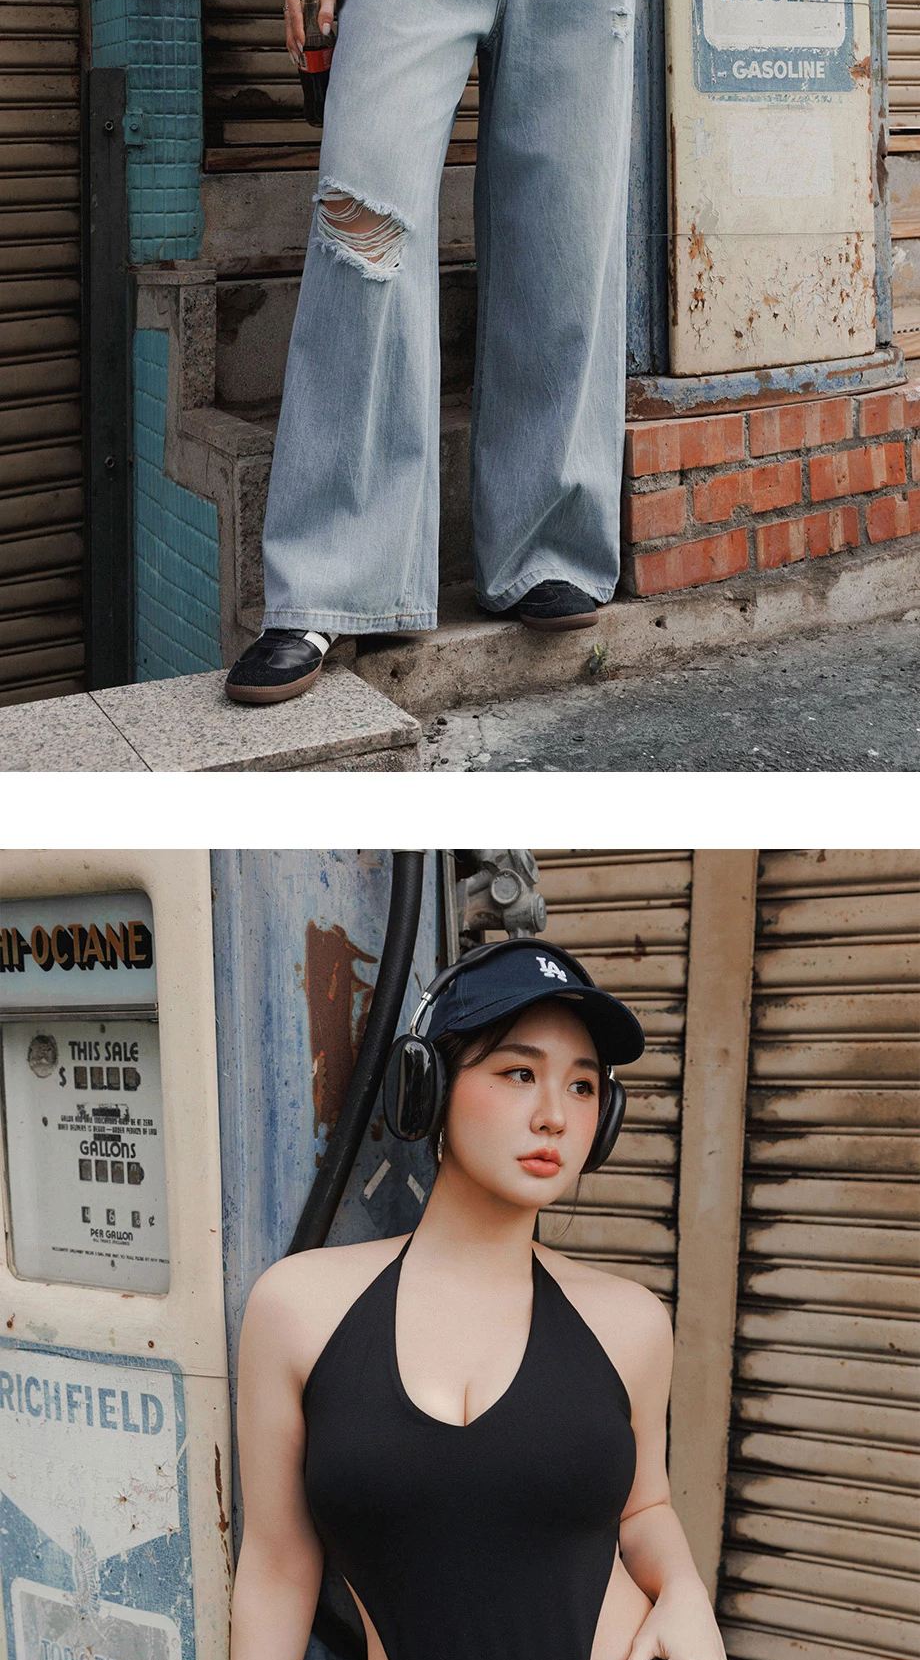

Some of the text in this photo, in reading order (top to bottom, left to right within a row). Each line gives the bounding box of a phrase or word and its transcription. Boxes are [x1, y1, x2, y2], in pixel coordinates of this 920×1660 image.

[732, 60, 826, 79] GASOLINE
[536, 956, 568, 983] LA
[68, 1040, 140, 1062] THIS SALE
[80, 1140, 137, 1159] GALLONS
[90, 1228, 134, 1241] PER GALLON
[0, 1370, 164, 1436] RICHFIELD
